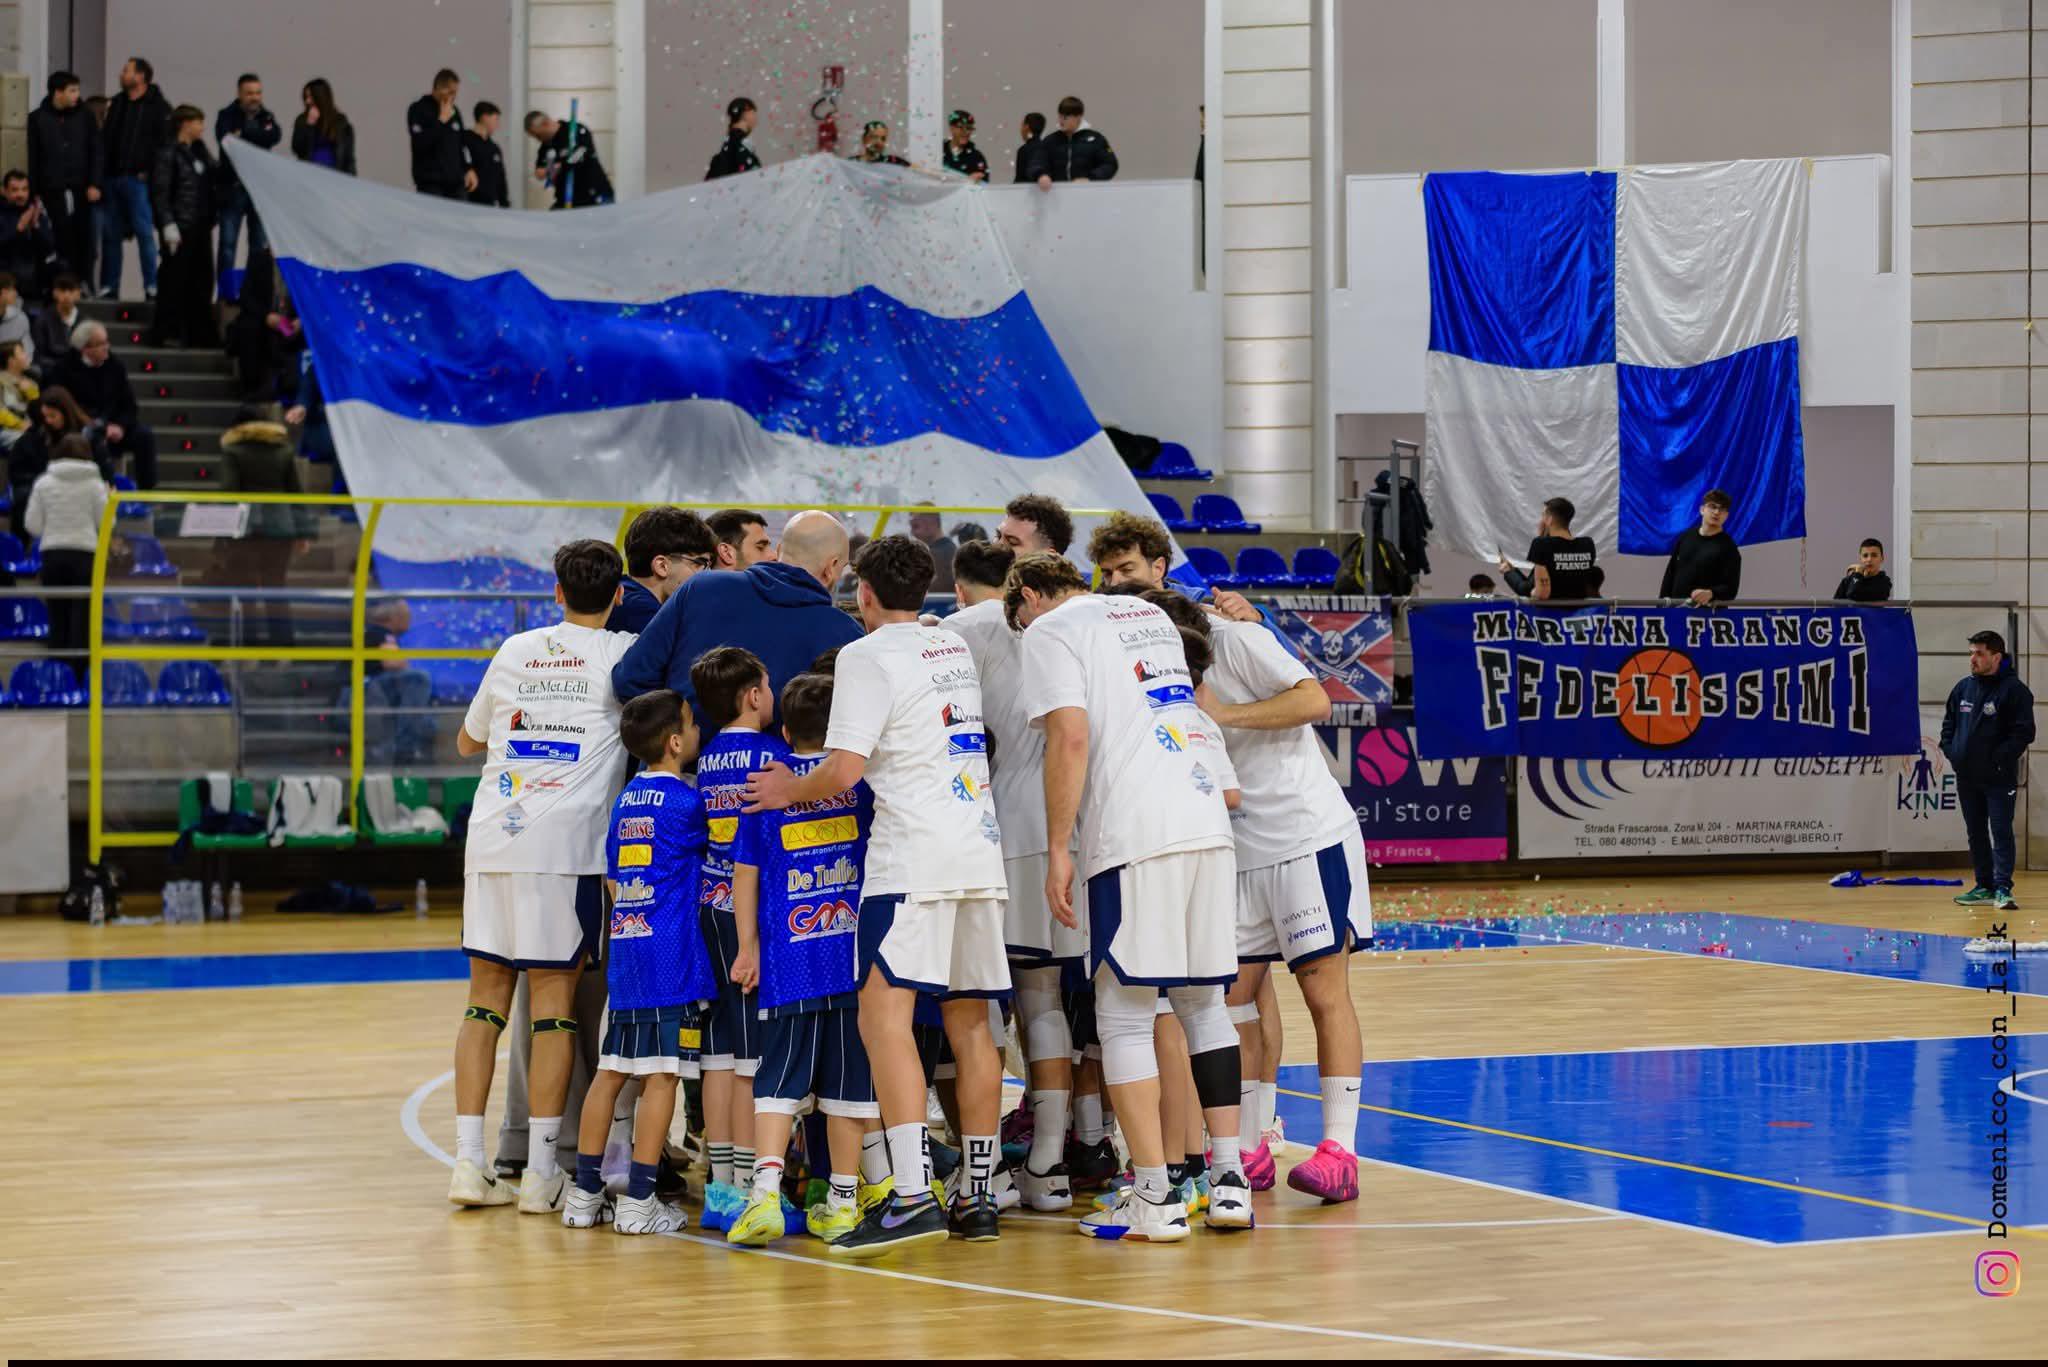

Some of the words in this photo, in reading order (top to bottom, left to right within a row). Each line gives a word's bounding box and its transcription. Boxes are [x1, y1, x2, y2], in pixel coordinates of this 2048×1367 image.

[1473, 610, 1669, 646] MARTINA
[1686, 616, 1867, 647] FRANCA
[525, 656, 585, 668] cheramie
[1475, 645, 1870, 735] FEDELISSIMI
[544, 724, 586, 735] MARANGI
[698, 750, 752, 774] AMATIN
[1773, 755, 1884, 777] GIUSEPPE
[620, 789, 665, 808] SPALLUTO
[1897, 771, 1957, 810] KINE
[1584, 823, 1615, 834] Strada
[1708, 821, 1722, 832] 204
[1736, 821, 1783, 831] MARTINA
[1784, 820, 1824, 831] FRANCA
[1599, 836, 1617, 847] 080
[1386, 846, 1432, 858] Franca
[787, 869, 814, 893] De
